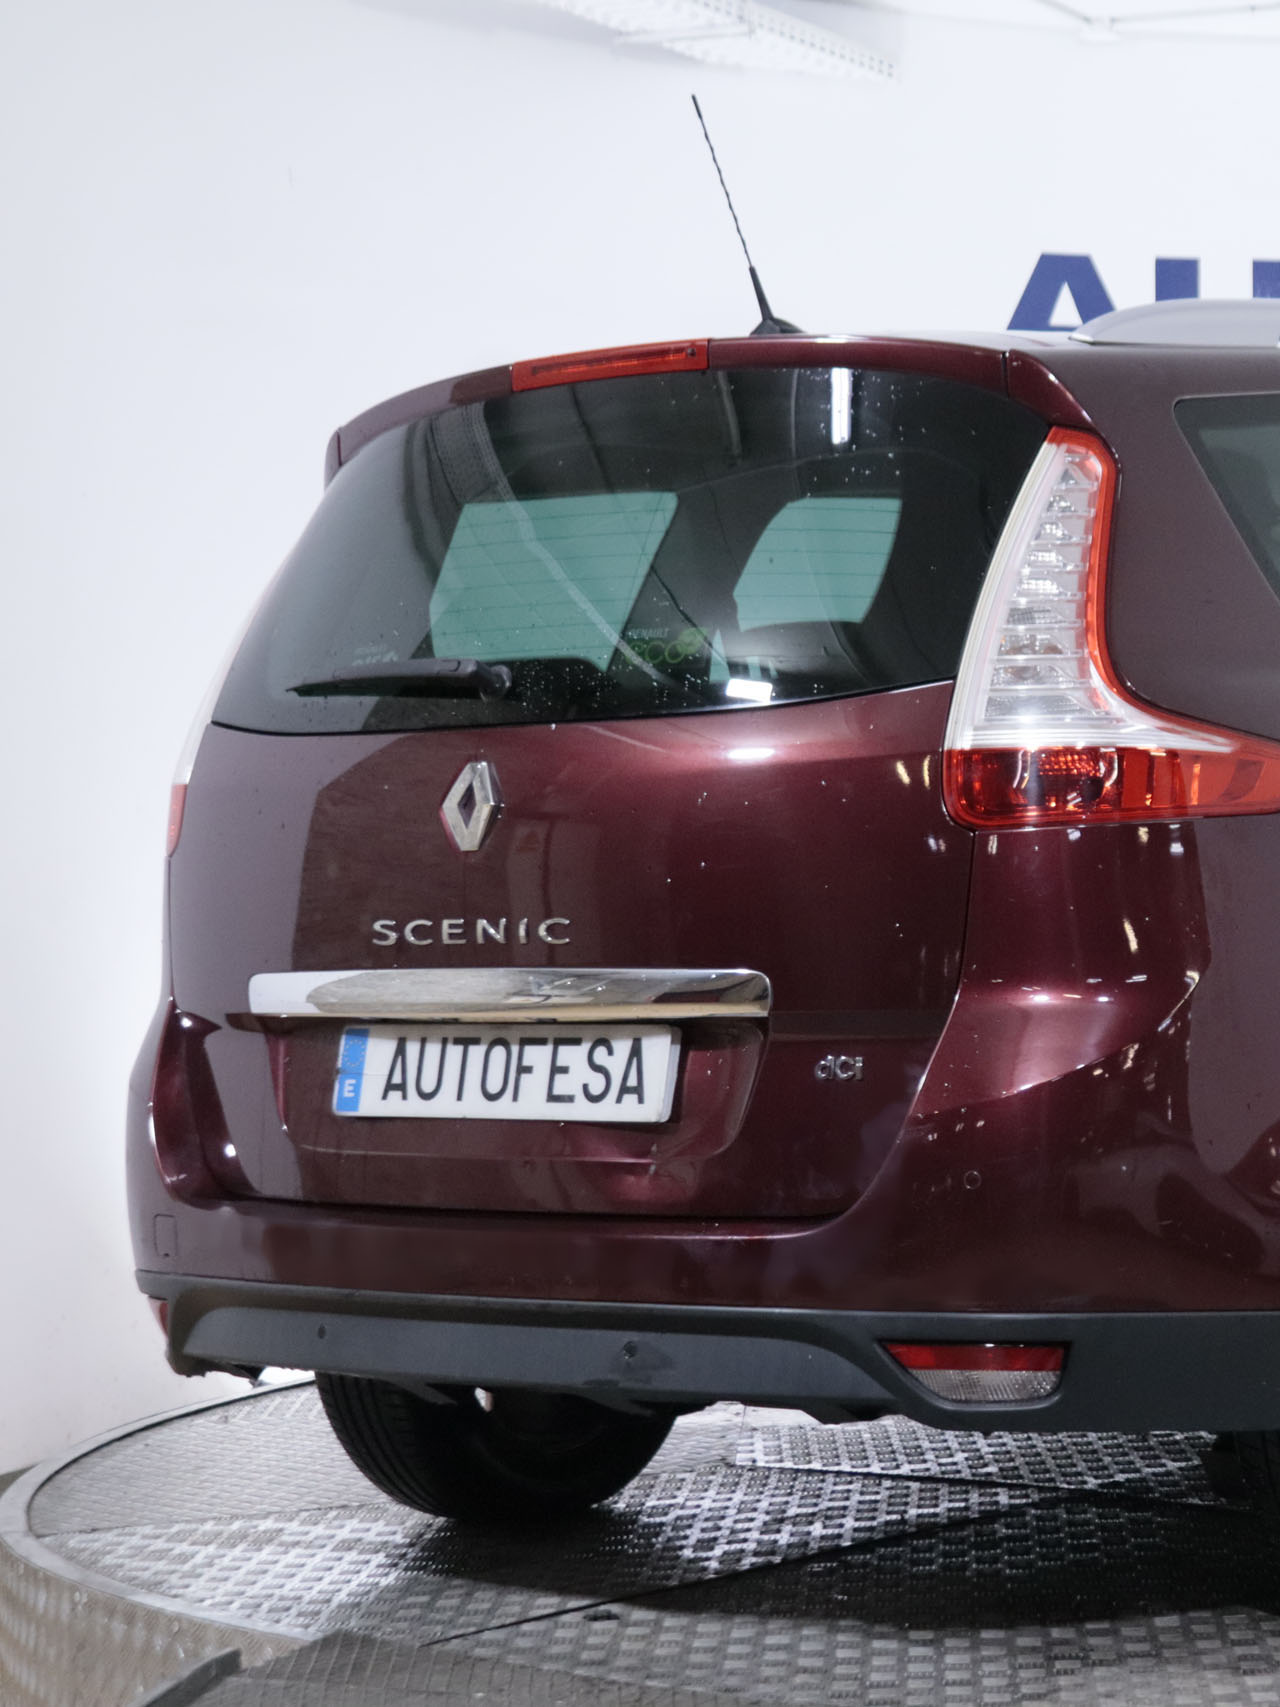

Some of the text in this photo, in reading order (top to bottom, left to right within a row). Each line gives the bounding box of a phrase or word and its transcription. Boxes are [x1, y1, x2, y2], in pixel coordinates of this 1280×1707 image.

[371, 917, 570, 946] SCENIC
[343, 1036, 645, 1105] E AUTOFESA
[814, 1054, 863, 1080] dCi
